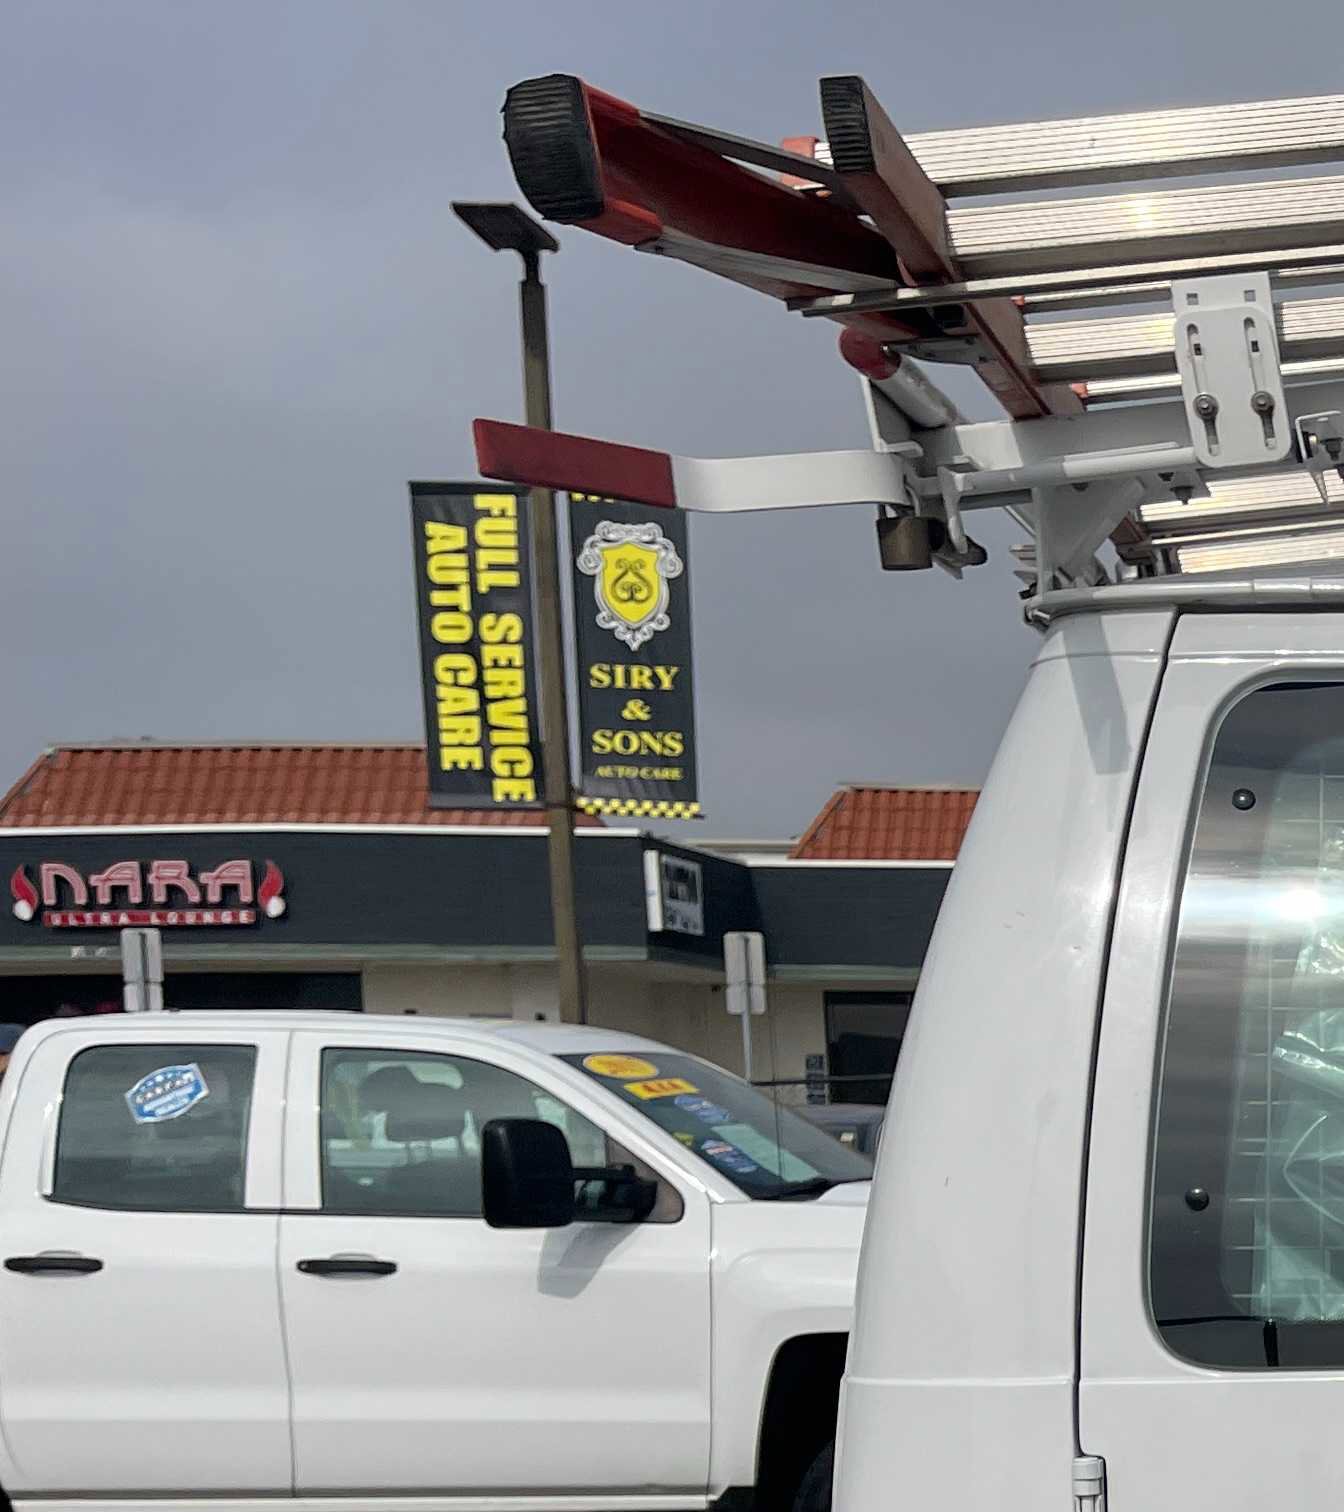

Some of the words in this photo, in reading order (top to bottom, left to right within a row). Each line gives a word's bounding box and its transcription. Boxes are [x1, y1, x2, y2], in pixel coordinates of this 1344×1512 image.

[474, 493, 520, 594] FULL
[425, 521, 473, 643] AUTO
[479, 612, 537, 802] SERVICE
[590, 663, 679, 690] SIRY
[434, 653, 484, 771] CARE
[621, 699, 651, 721] &
[591, 729, 684, 757] SONS
[595, 765, 638, 778] AUTO
